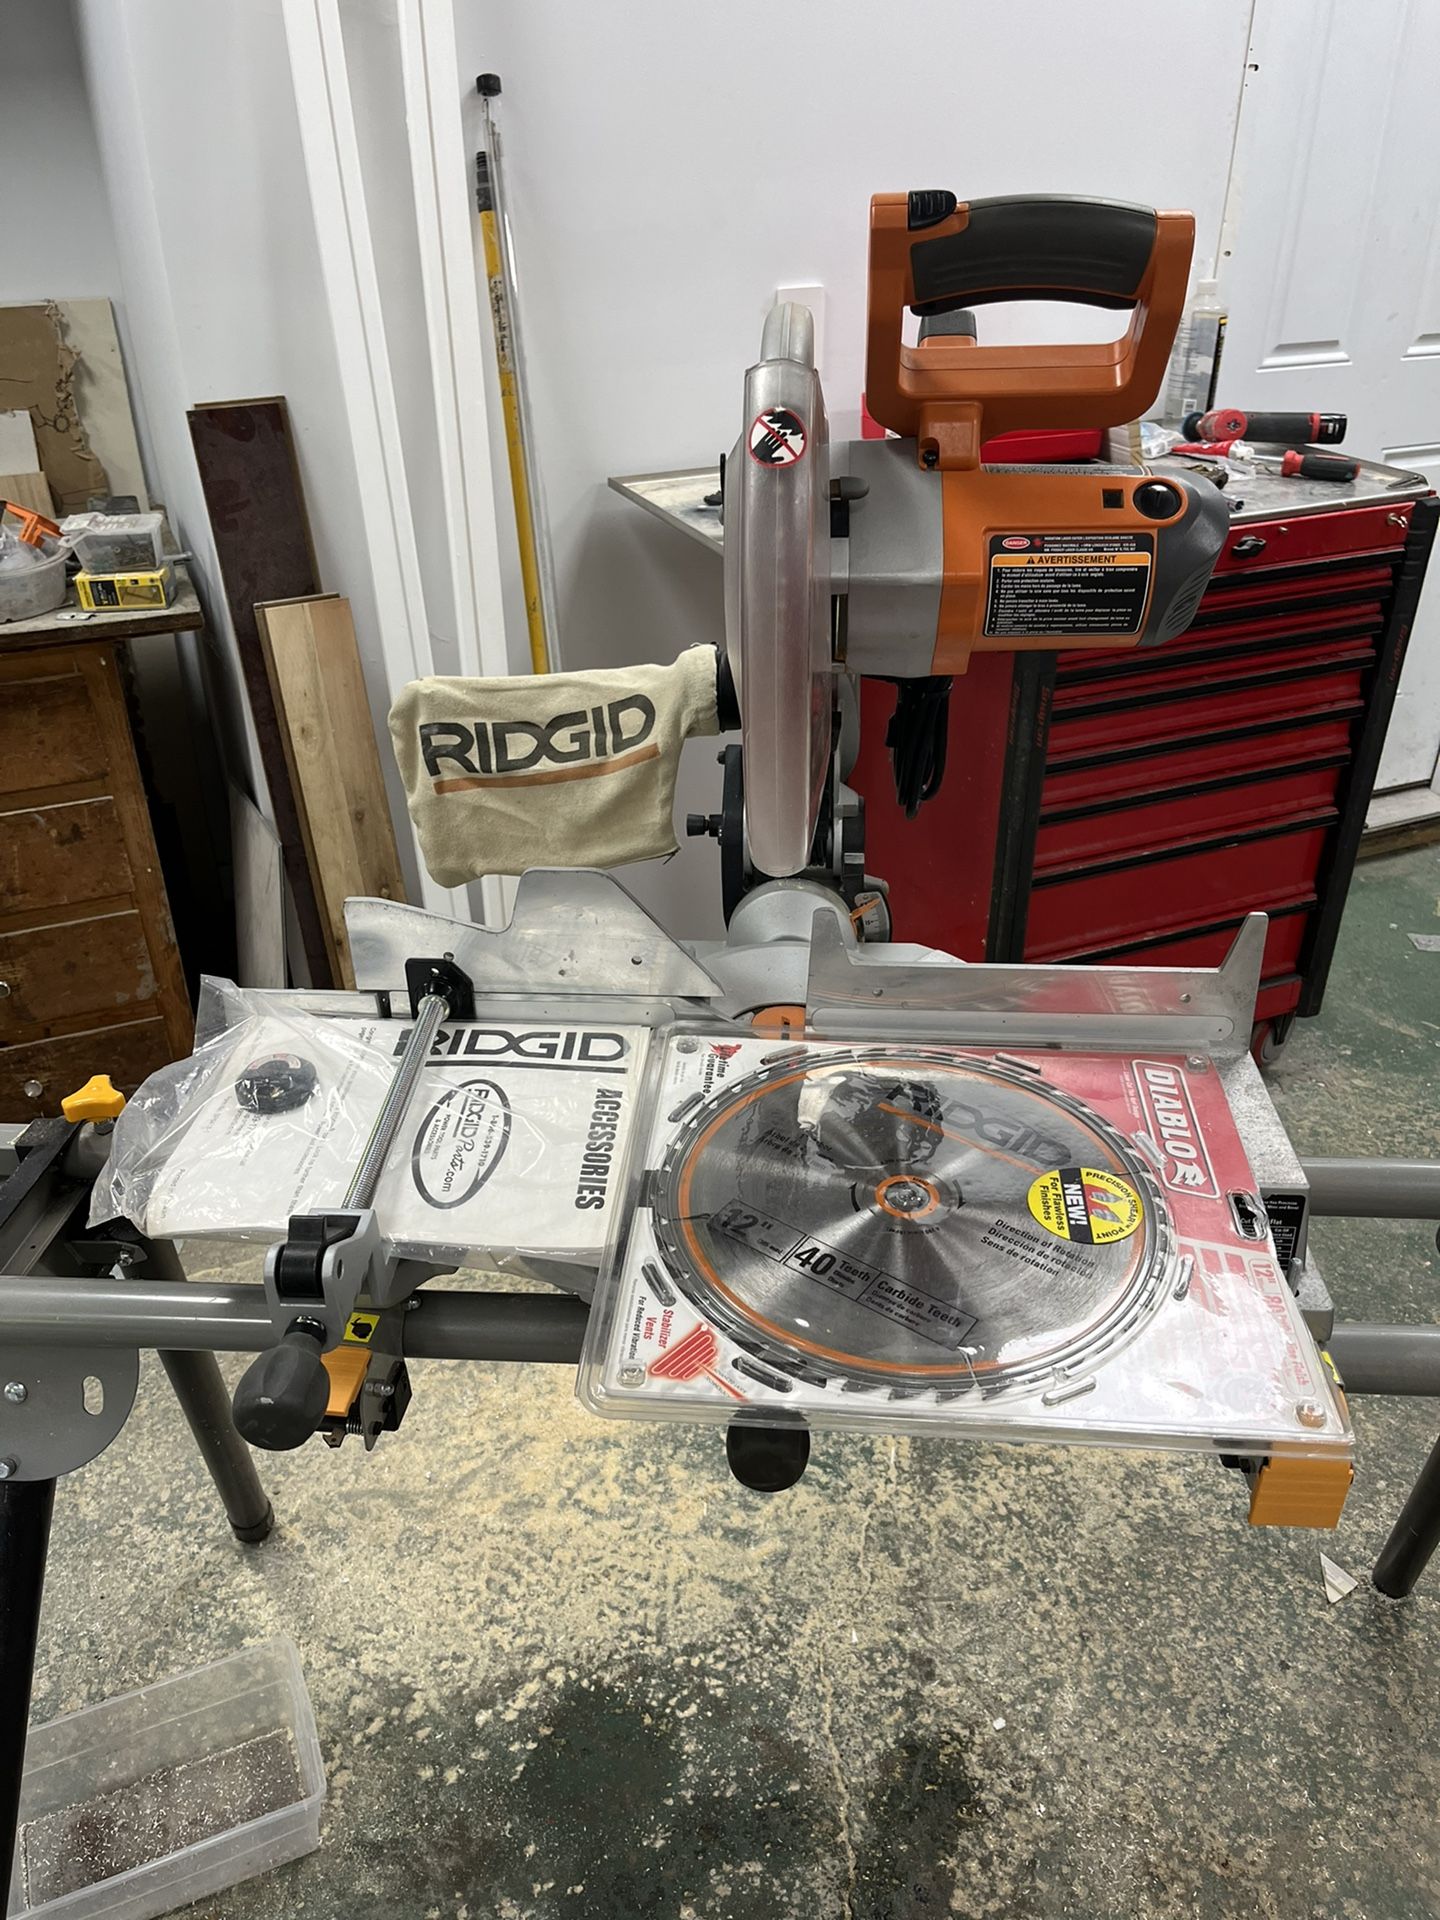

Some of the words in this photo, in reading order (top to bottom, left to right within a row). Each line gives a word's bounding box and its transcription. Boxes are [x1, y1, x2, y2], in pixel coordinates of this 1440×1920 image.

[1037, 555, 1117, 564] AVERTISSEMENT
[419, 694, 656, 777] RIDGID
[393, 1028, 631, 1061] RIDGID
[703, 1054, 719, 1094] Guarantee
[1144, 1068, 1198, 1159] DIABLO
[575, 1088, 623, 1210] ACCESSORIES
[1050, 1177, 1059, 1191] For
[1086, 1171, 1132, 1198] PRECISION
[1040, 1185, 1051, 1221] Finishes
[1052, 1193, 1065, 1231] Flawless
[1064, 1183, 1088, 1225] NEW!
[996, 1219, 1039, 1244] Direction
[1040, 1240, 1052, 1248] of
[1053, 1245, 1095, 1268] Rotation
[1096, 1227, 1125, 1239] POINT
[794, 1246, 837, 1276] 40
[839, 1259, 872, 1282] Teeth
[981, 1236, 1004, 1252] Sens
[1006, 1248, 1019, 1258] de
[1020, 1254, 1059, 1276] rotation
[1037, 1249, 1049, 1259] de
[638, 1296, 647, 1305] For
[877, 1280, 925, 1310] Carbide
[927, 1304, 962, 1328] Teeth
[633, 1306, 645, 1332] Reduced
[643, 1317, 657, 1340] Vents
[659, 1309, 674, 1348] Stabilizer
[629, 1331, 640, 1359] Vibration
